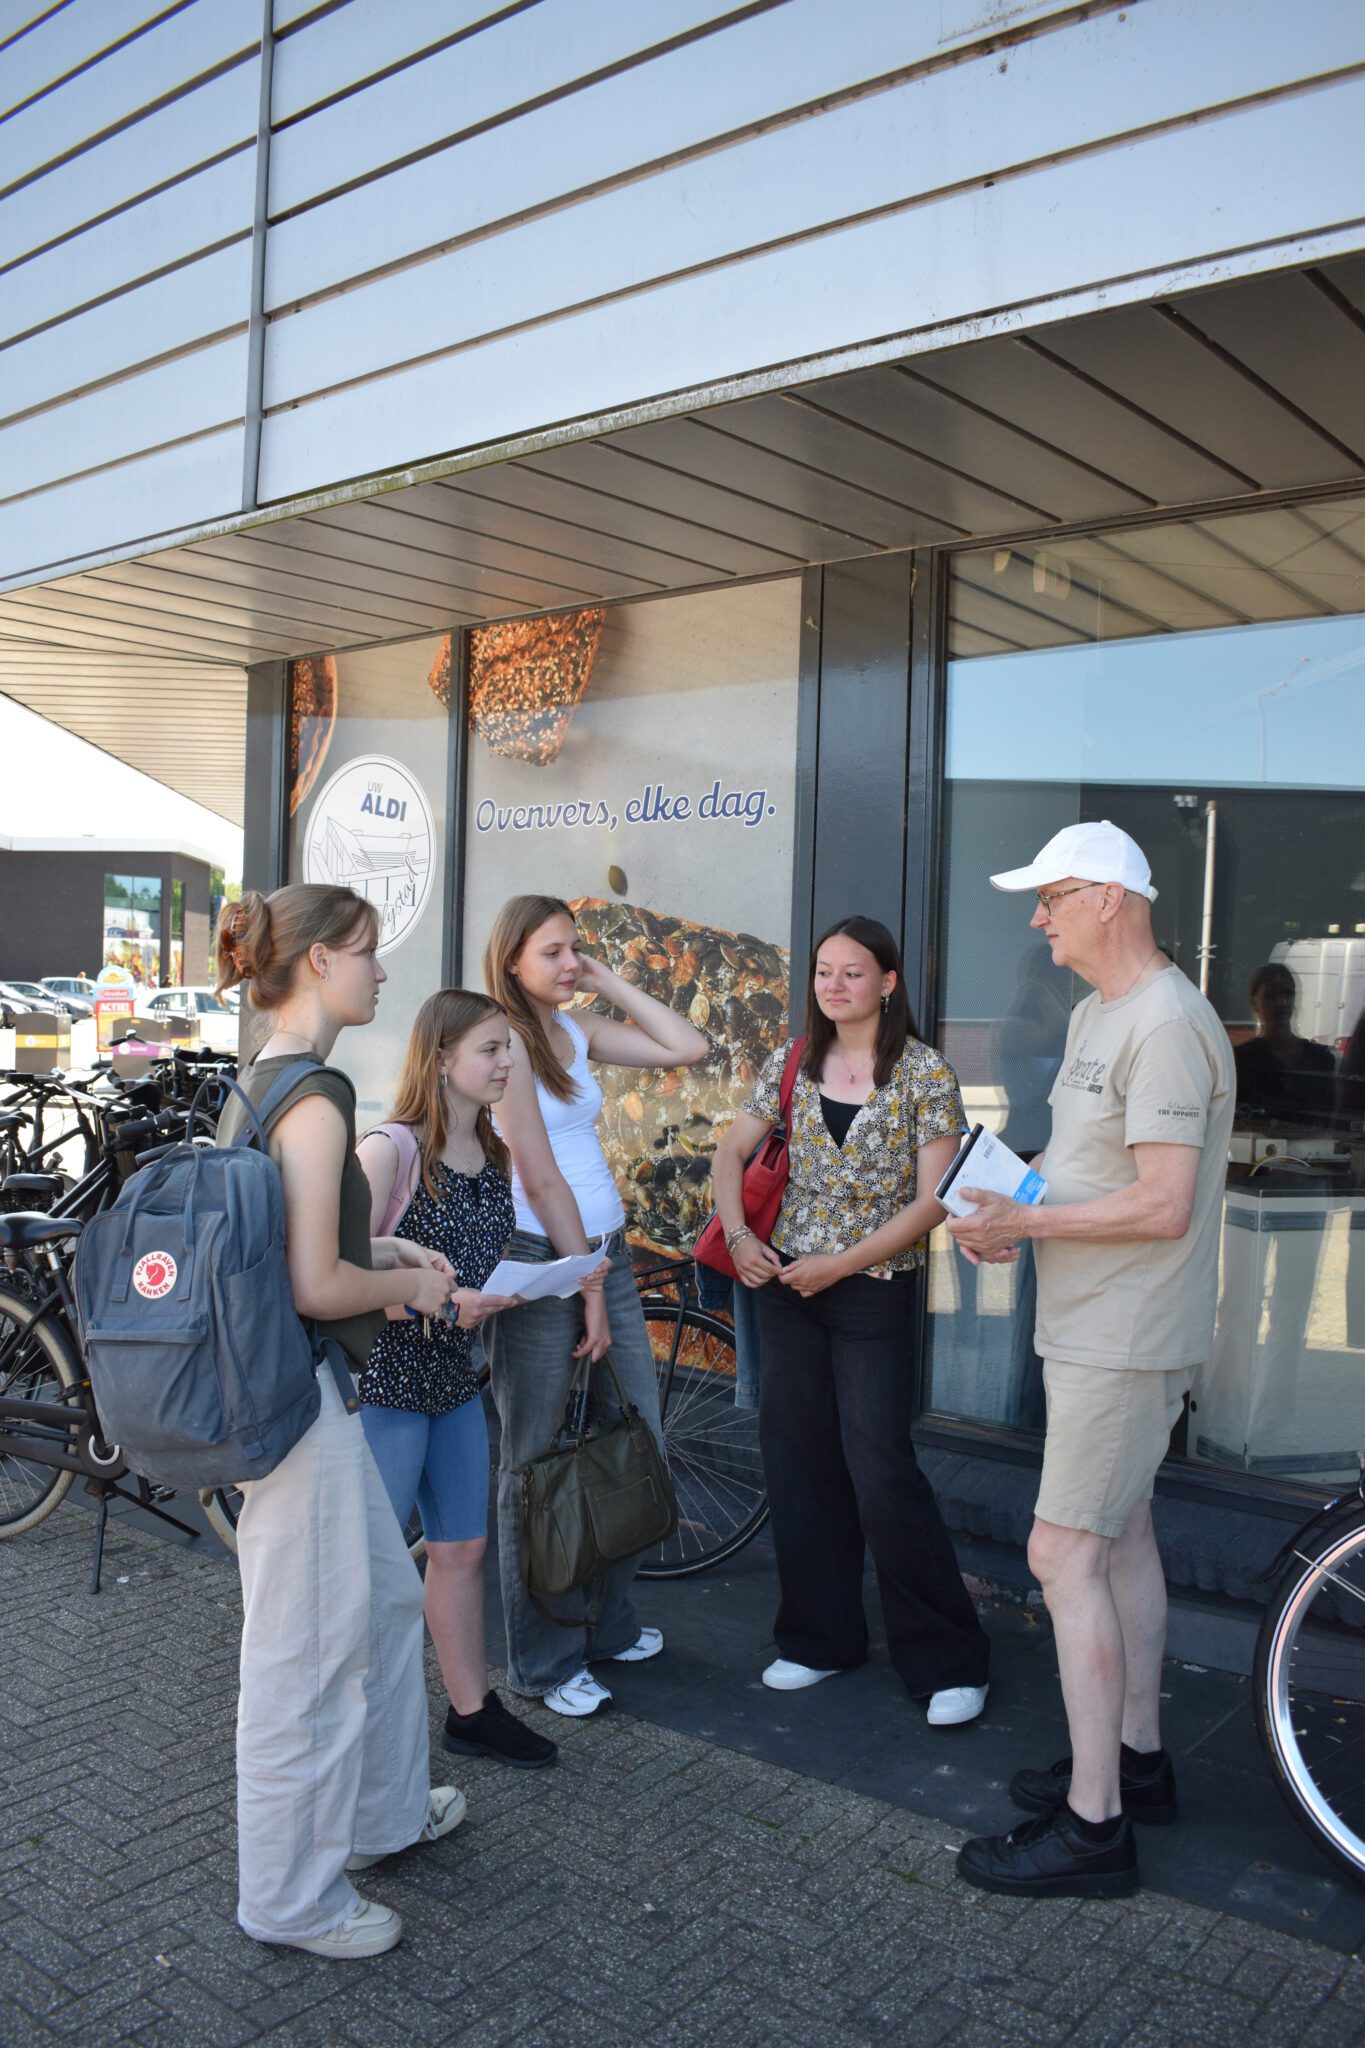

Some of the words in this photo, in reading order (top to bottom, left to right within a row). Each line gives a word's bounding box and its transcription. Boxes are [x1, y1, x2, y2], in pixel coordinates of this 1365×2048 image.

[367, 780, 384, 793] UW
[360, 792, 407, 822] ALDI
[476, 798, 618, 832] Ovenvers,
[624, 784, 692, 824] elke
[697, 779, 776, 828] dag.
